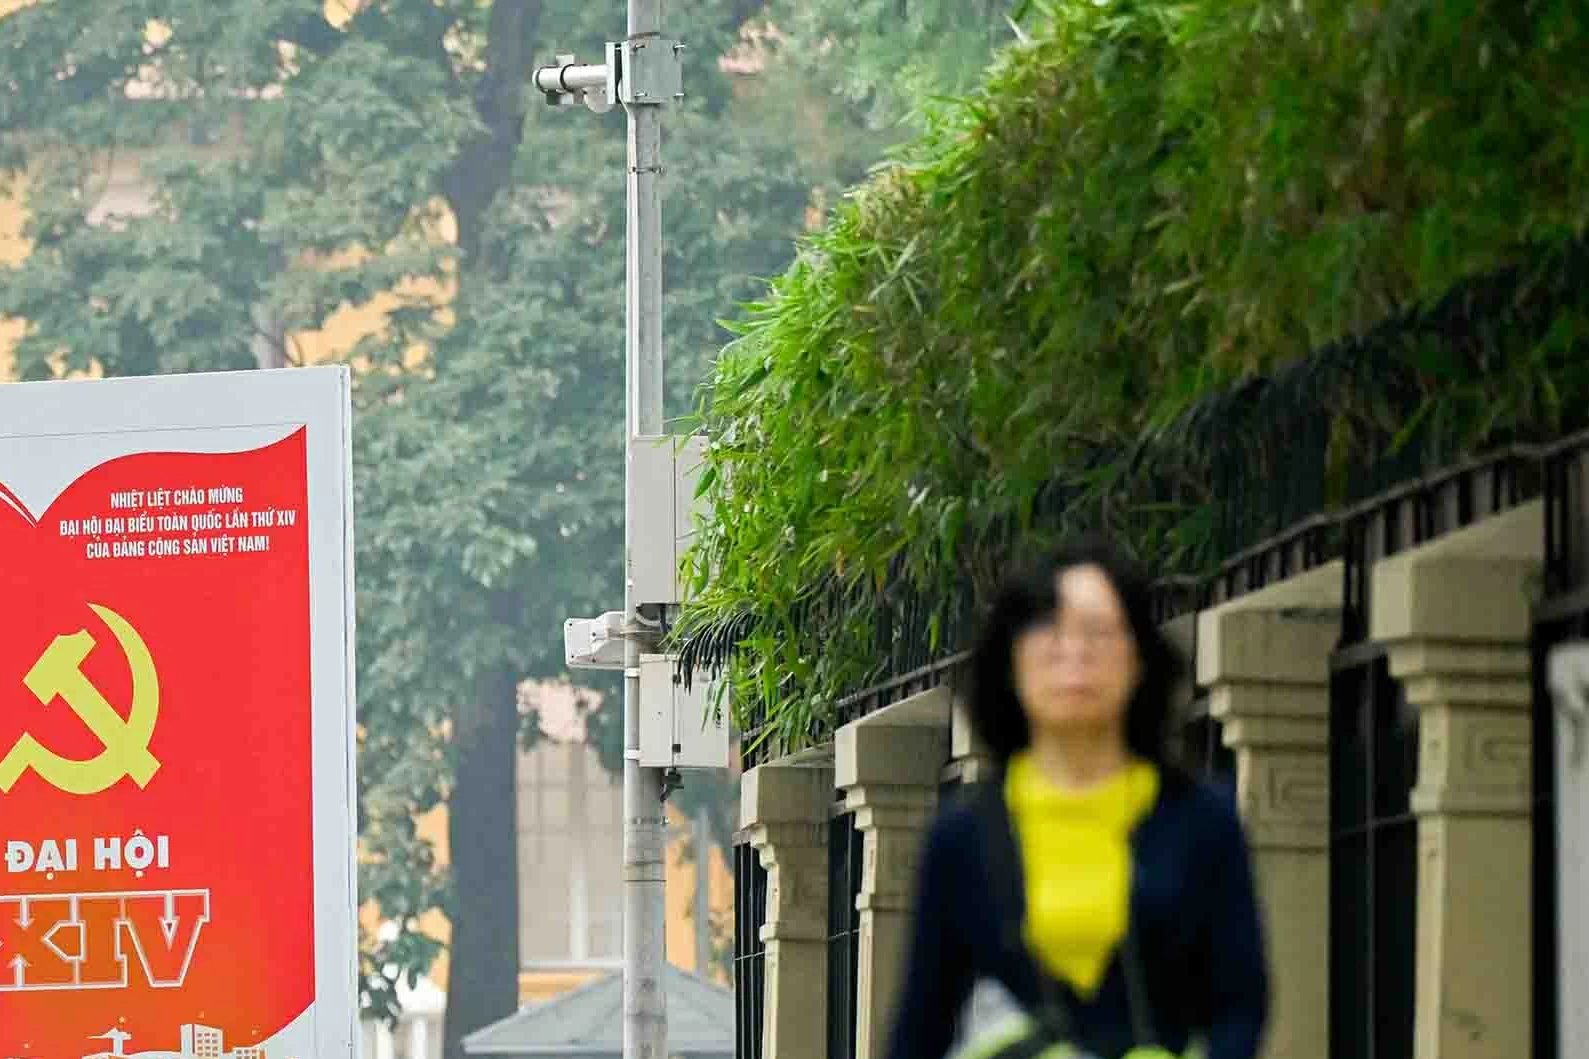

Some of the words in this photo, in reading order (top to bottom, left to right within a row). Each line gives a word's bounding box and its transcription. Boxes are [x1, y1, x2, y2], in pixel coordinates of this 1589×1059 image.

[110, 489, 144, 511] NHIỆT
[147, 488, 171, 510] LIỆT
[173, 486, 205, 506] CHÀO
[208, 484, 243, 504] MỪNG
[59, 519, 79, 540] ĐẠI
[82, 515, 102, 539] HỘI
[105, 517, 125, 538] ĐẠI
[128, 511, 154, 534] BIỂU
[157, 512, 188, 531] TOÀN
[191, 509, 222, 533] QUỐC
[251, 505, 275, 527] THỨ
[277, 510, 296, 526] XIV
[86, 537, 110, 559] CỦA
[113, 535, 145, 557] ĐẢNG
[148, 537, 180, 558] CỘNG
[183, 532, 207, 555] SẢN
[210, 534, 235, 556] VIỆT
[238, 535, 270, 552] NAM!
[5, 838, 77, 880] ĐẠI
[93, 828, 169, 878] HỘI
